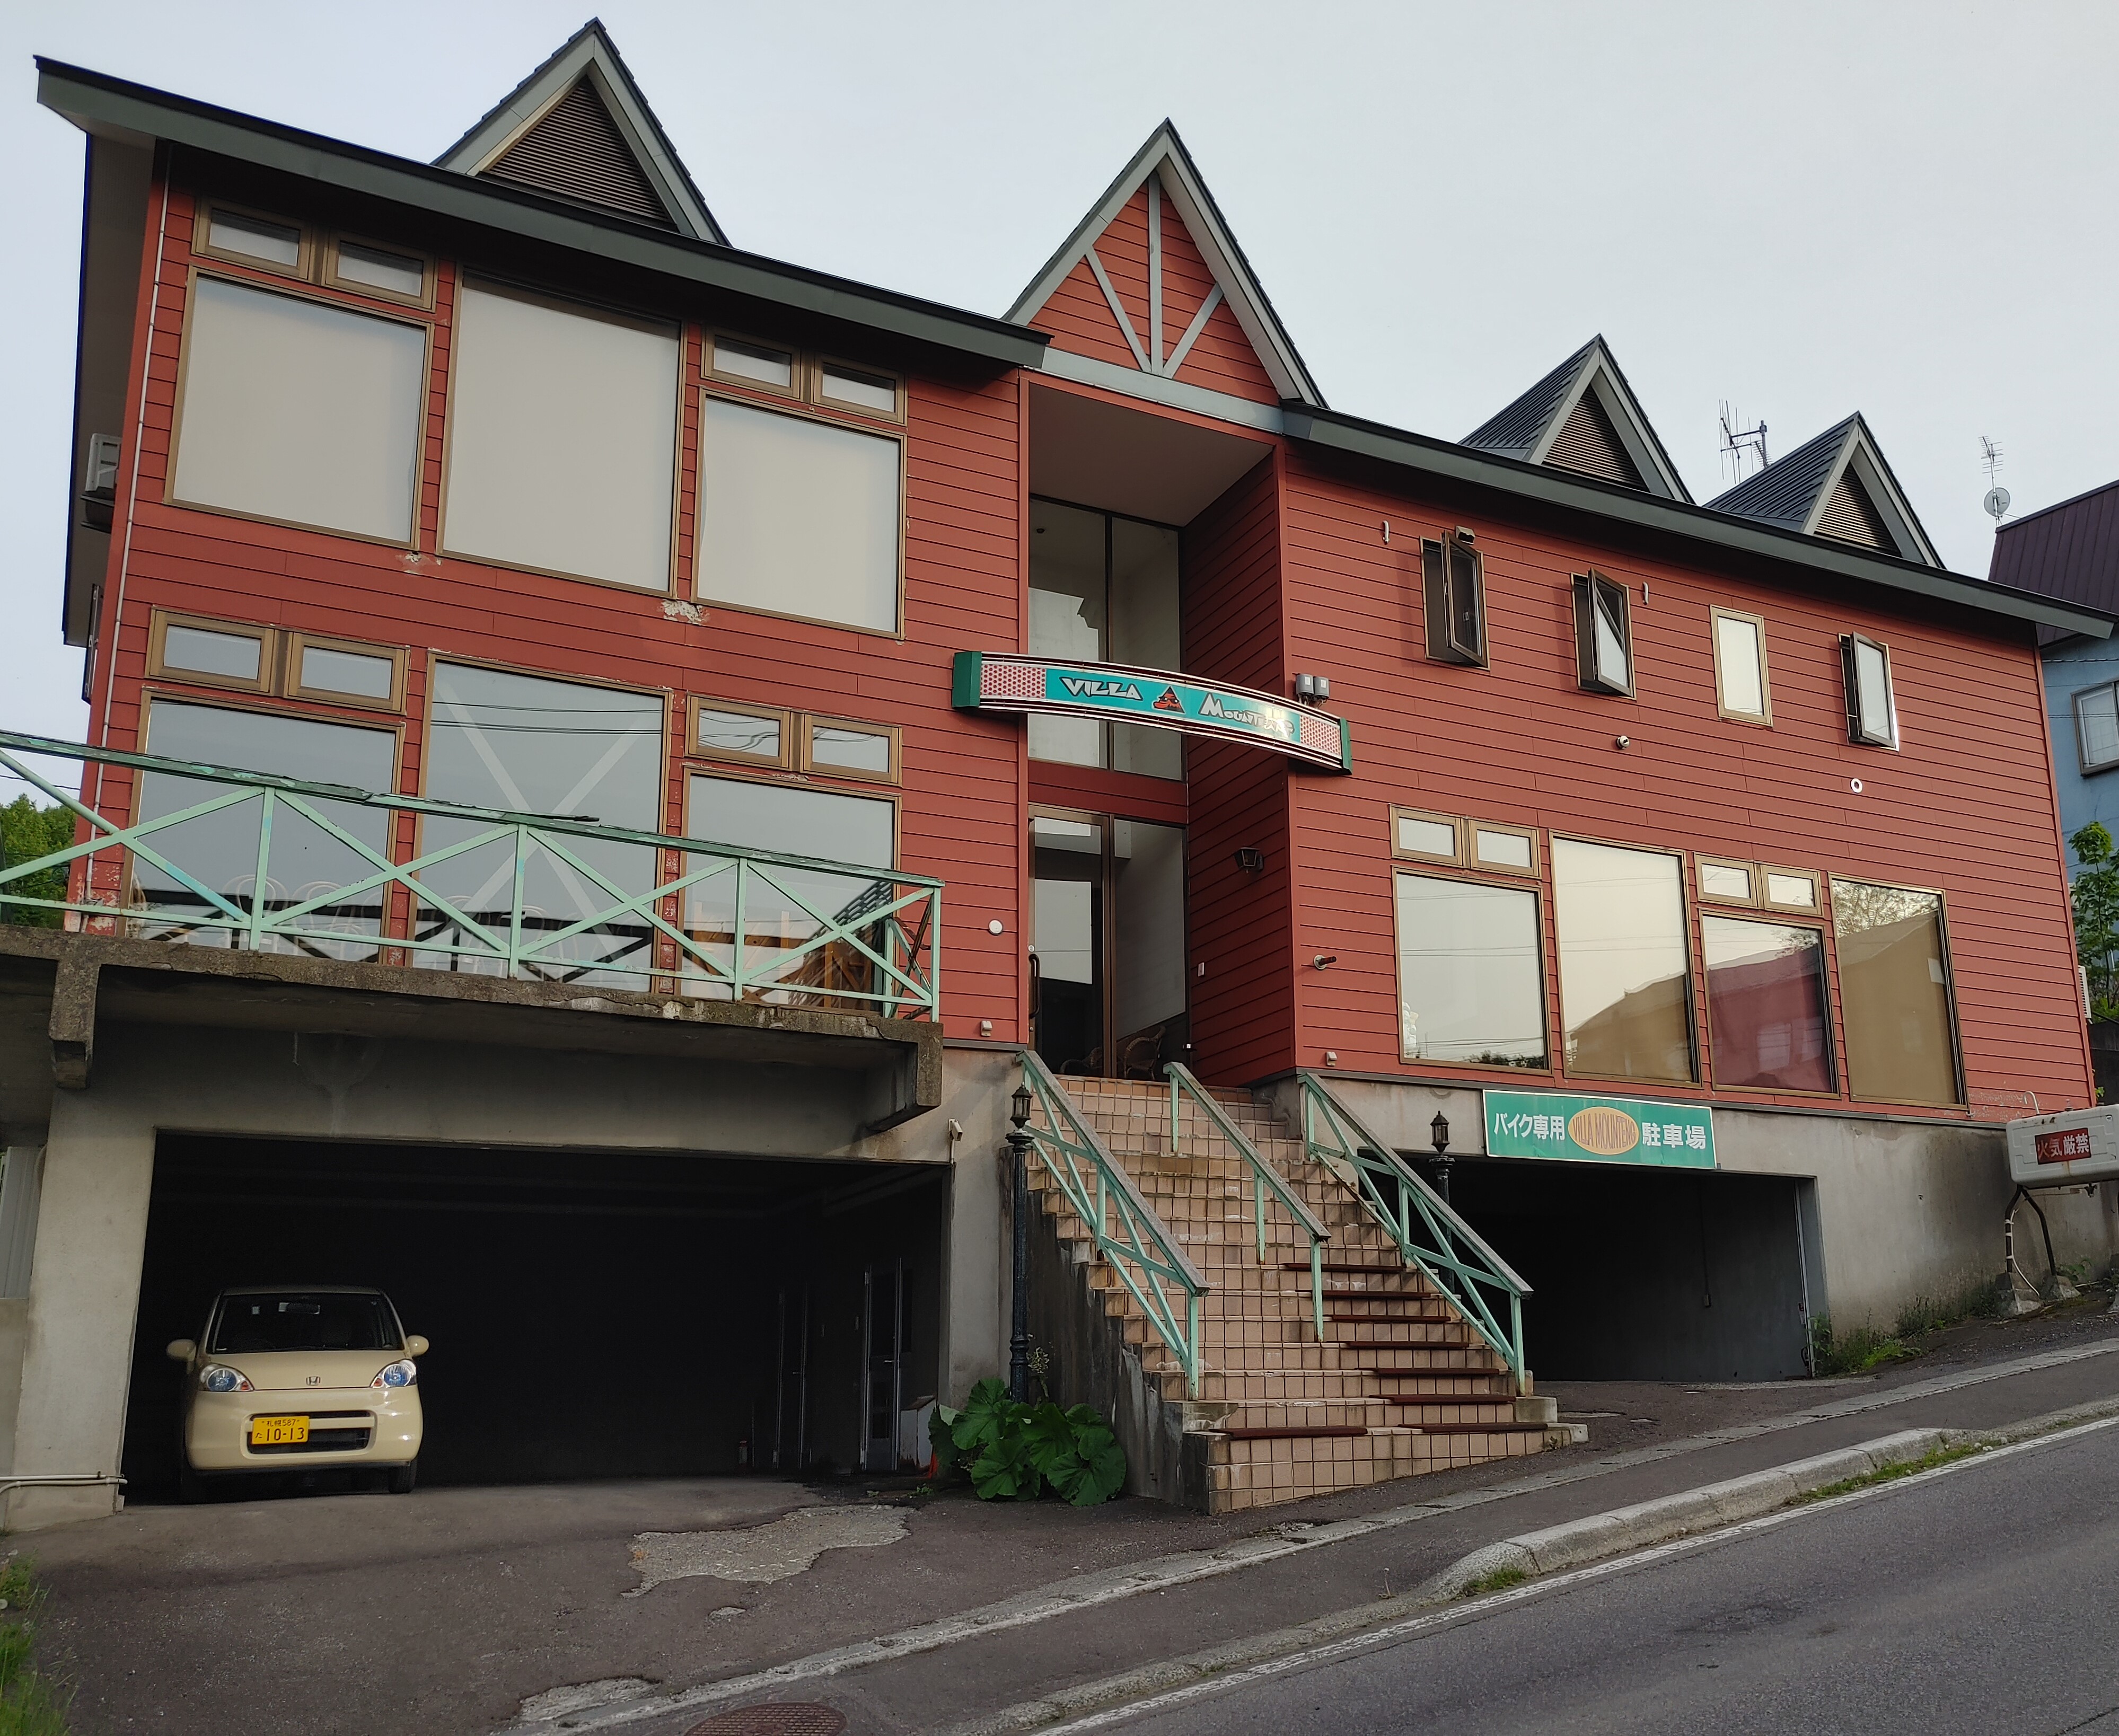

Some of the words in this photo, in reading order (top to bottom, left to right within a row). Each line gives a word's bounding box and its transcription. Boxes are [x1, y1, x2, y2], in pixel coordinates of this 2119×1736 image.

[1059, 676, 1143, 701] VILLA
[1494, 1113, 1566, 1140] バイク専用
[1572, 1113, 1594, 1147] VILLA
[1594, 1113, 1636, 1149] MOUNTENG
[1642, 1122, 1707, 1149] 駐車場
[2037, 1133, 2089, 1158] 火気厳禁
[267, 1427, 304, 1441] 10-13
